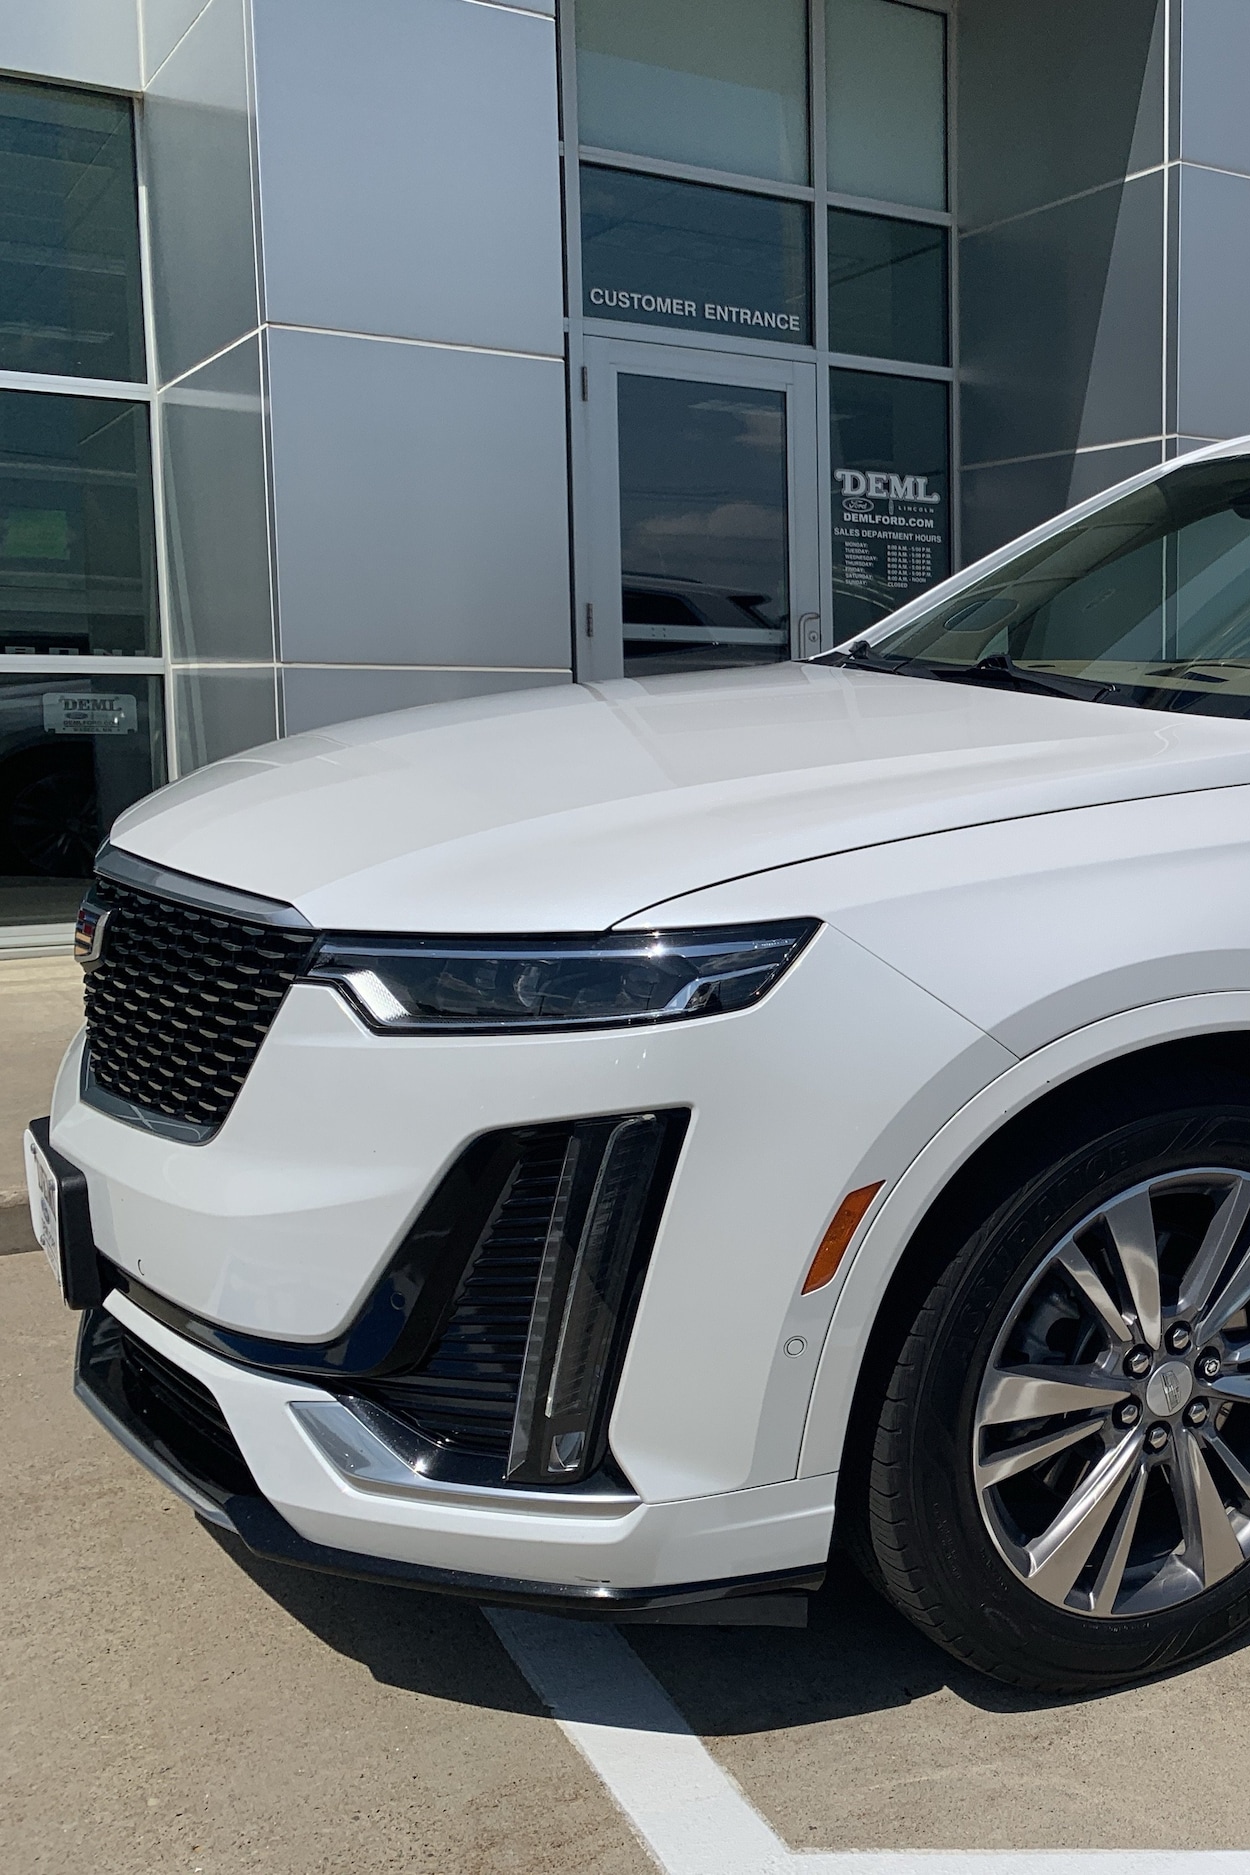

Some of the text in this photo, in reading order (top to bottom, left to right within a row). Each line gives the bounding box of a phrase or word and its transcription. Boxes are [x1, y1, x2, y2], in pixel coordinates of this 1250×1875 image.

[590, 288, 800, 331] CUSTOMER ENTRANCE
[834, 468, 940, 504] DEML
[898, 505, 934, 513] LINCOLN
[843, 512, 934, 528] DEMLFORD.COM
[834, 527, 942, 543] SALES DEPARTMENT HOURS
[59, 698, 122, 711] DEML
